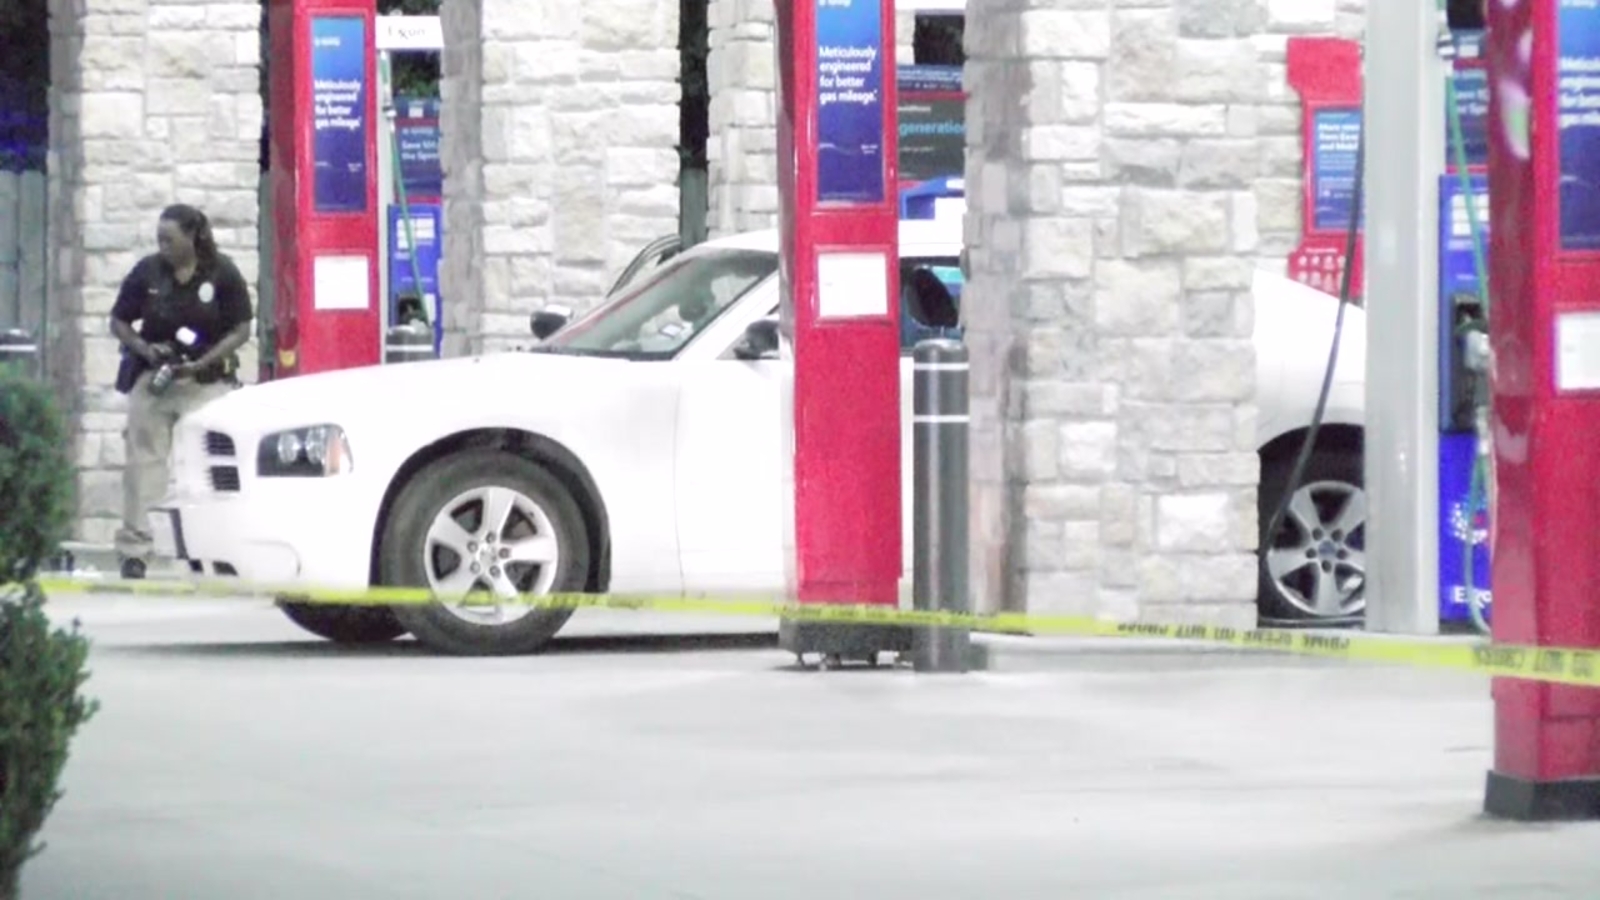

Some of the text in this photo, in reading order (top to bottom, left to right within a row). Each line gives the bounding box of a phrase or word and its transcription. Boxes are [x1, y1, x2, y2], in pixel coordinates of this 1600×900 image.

[819, 45, 876, 60] Meticulously
[819, 59, 871, 74] engineered
[819, 74, 865, 87] for better
[819, 92, 836, 105] gas
